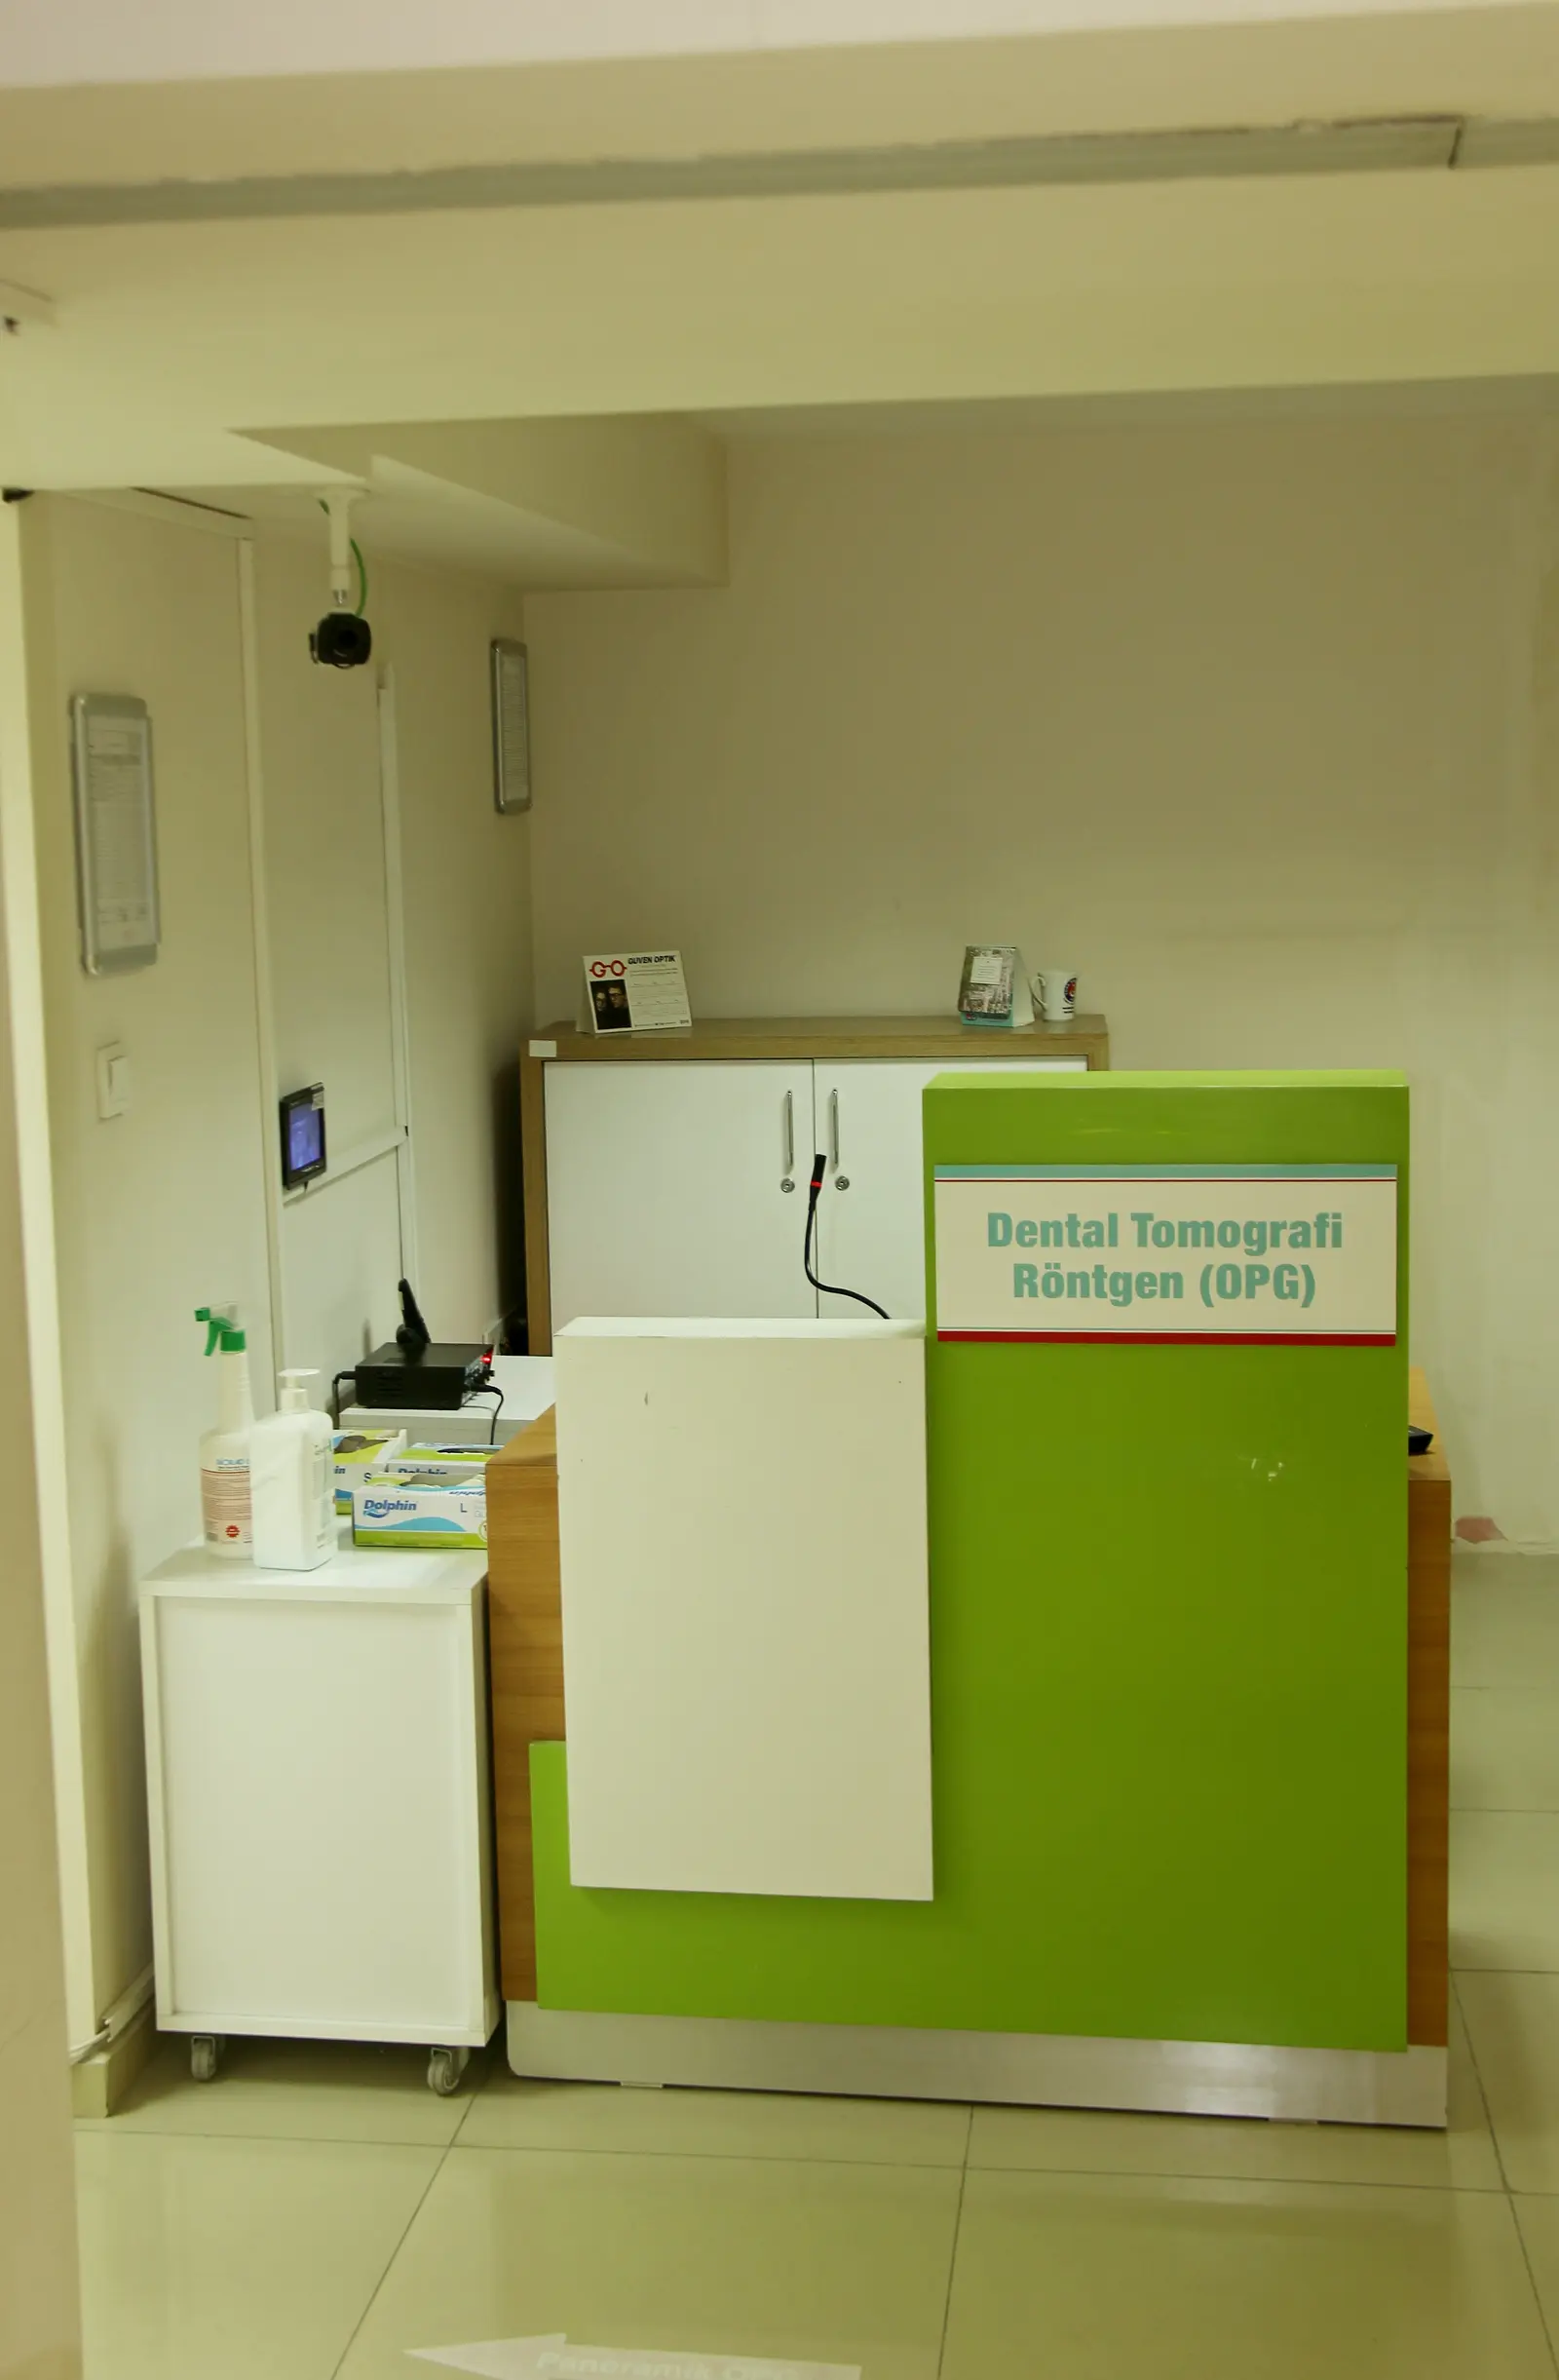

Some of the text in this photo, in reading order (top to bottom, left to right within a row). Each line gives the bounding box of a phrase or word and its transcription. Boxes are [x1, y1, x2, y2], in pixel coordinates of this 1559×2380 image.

[987, 1212, 1344, 1256] Dental Tomografi
[1012, 1262, 1316, 1308] Röntgen (OPG)
[363, 1499, 418, 1513] Dolphin
[460, 1503, 468, 1514] L
